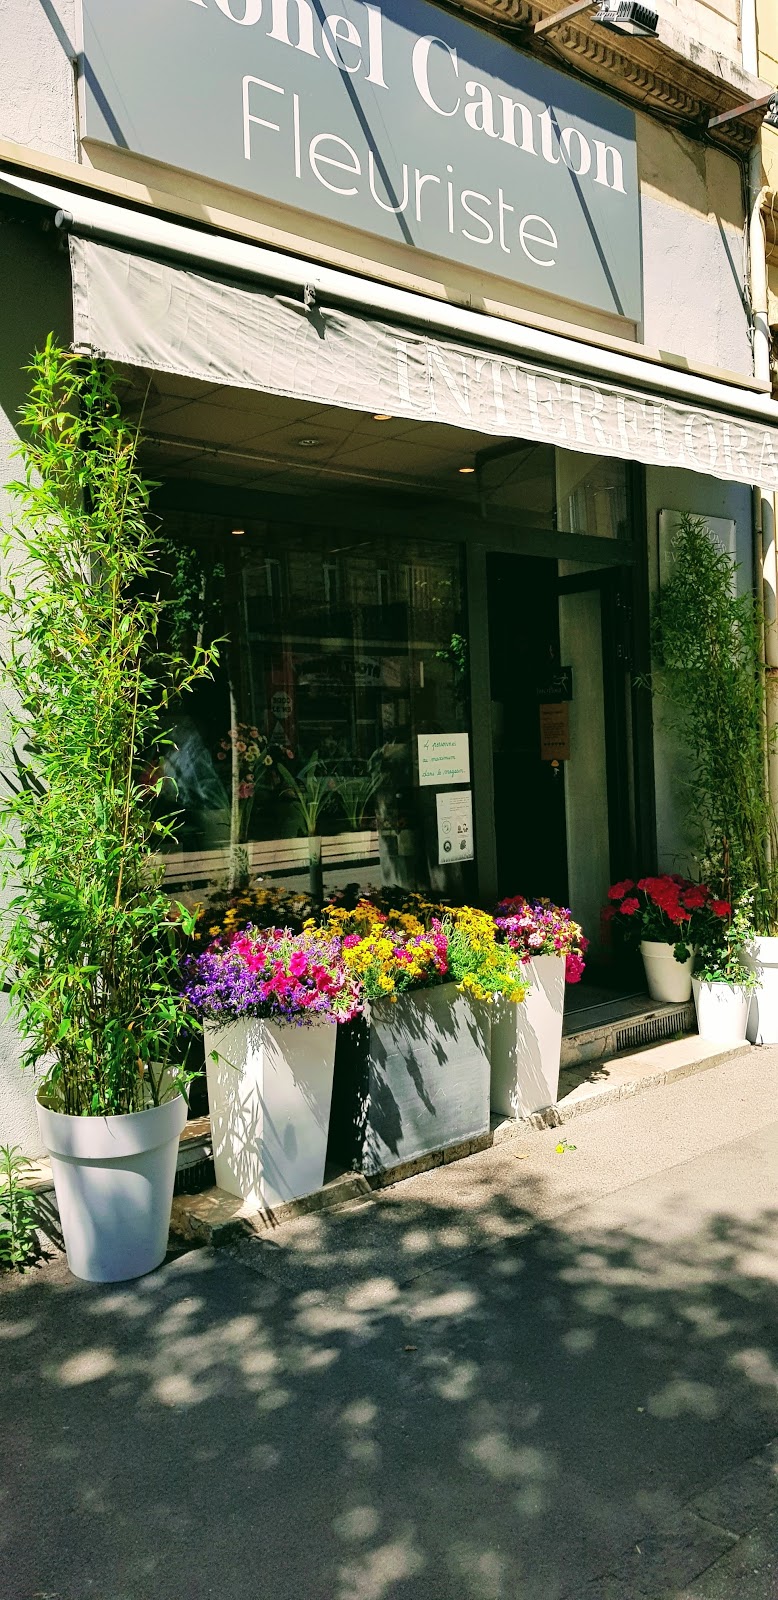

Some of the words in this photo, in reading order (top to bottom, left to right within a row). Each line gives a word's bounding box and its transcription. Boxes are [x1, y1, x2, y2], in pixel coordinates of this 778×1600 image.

[242, 74, 559, 267] Fleuriste
[411, 35, 628, 195] Canton
[394, 337, 778, 481] INTERFLORA
